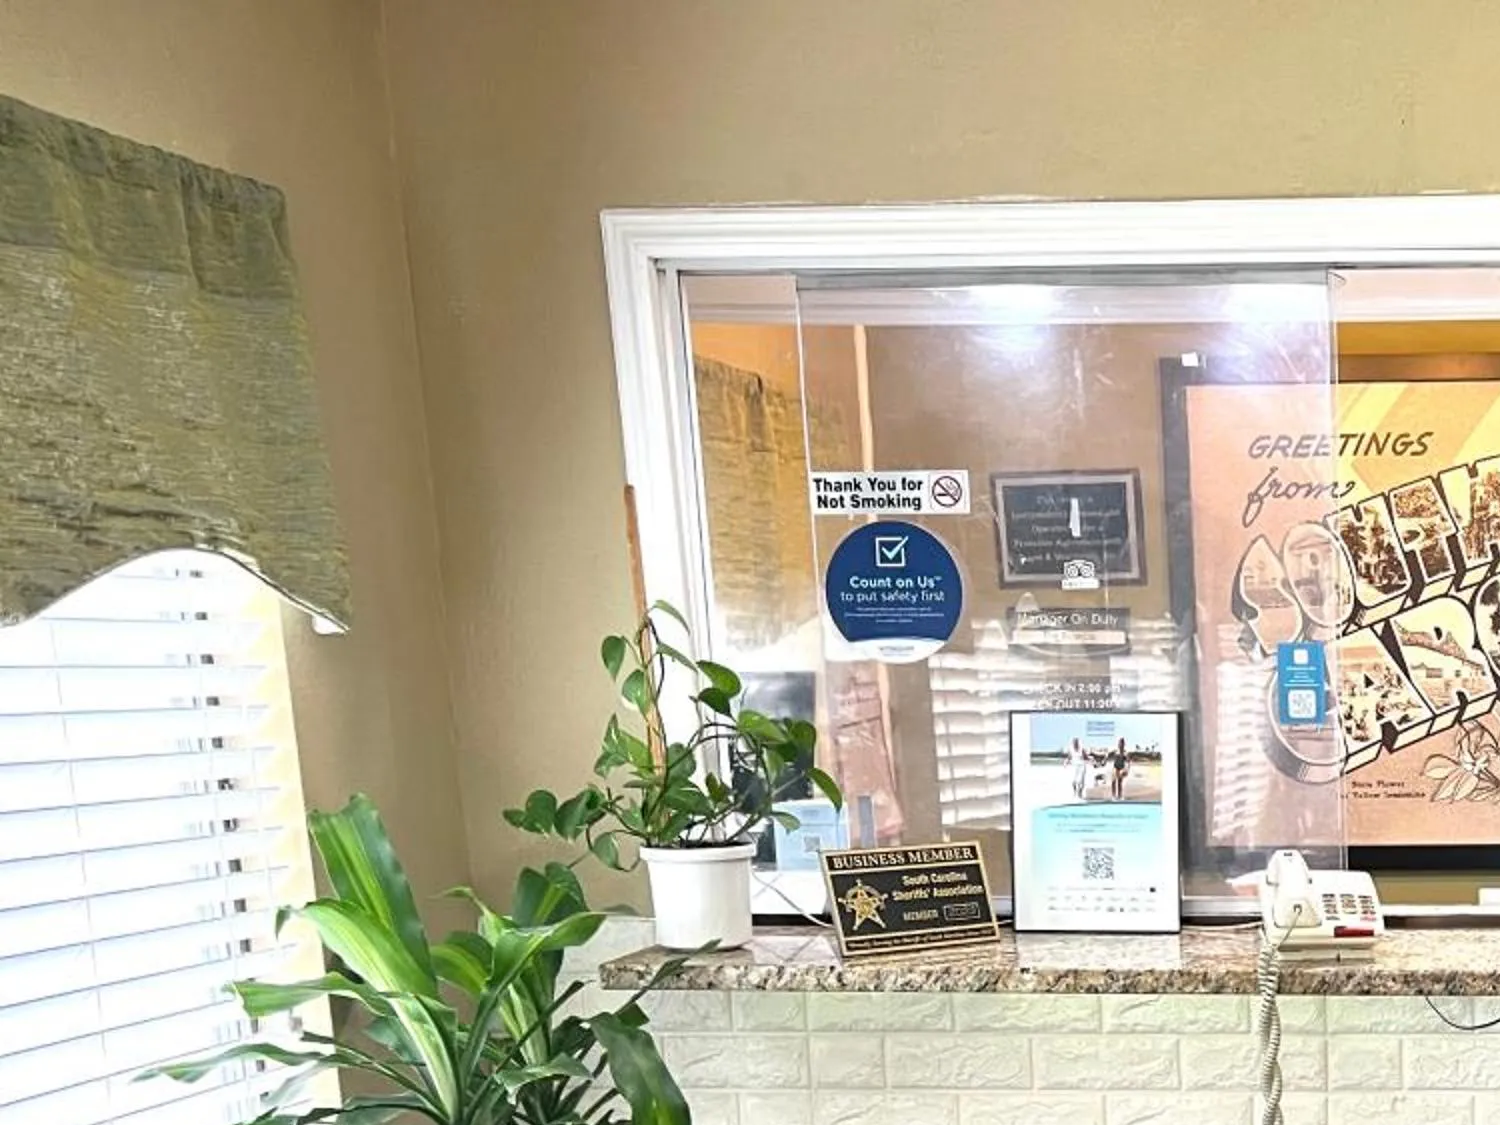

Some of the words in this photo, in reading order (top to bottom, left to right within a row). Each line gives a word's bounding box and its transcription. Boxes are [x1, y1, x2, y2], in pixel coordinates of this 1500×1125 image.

[1248, 431, 1434, 459] GREETINGS
[813, 477, 863, 493] Thank
[867, 477, 896, 491] You
[901, 476, 924, 490] for
[816, 495, 846, 509] Not
[850, 493, 922, 511] Smoking
[1242, 466, 1357, 528] from
[849, 575, 891, 589] Count
[895, 577, 914, 588] on
[840, 590, 853, 601] to
[856, 590, 876, 603] put
[880, 588, 918, 605] safety
[920, 588, 945, 601] first
[832, 854, 906, 869] BUSINESS
[907, 847, 975, 864] MEMBER
[902, 874, 930, 886] South
[931, 872, 968, 883] Carolina
